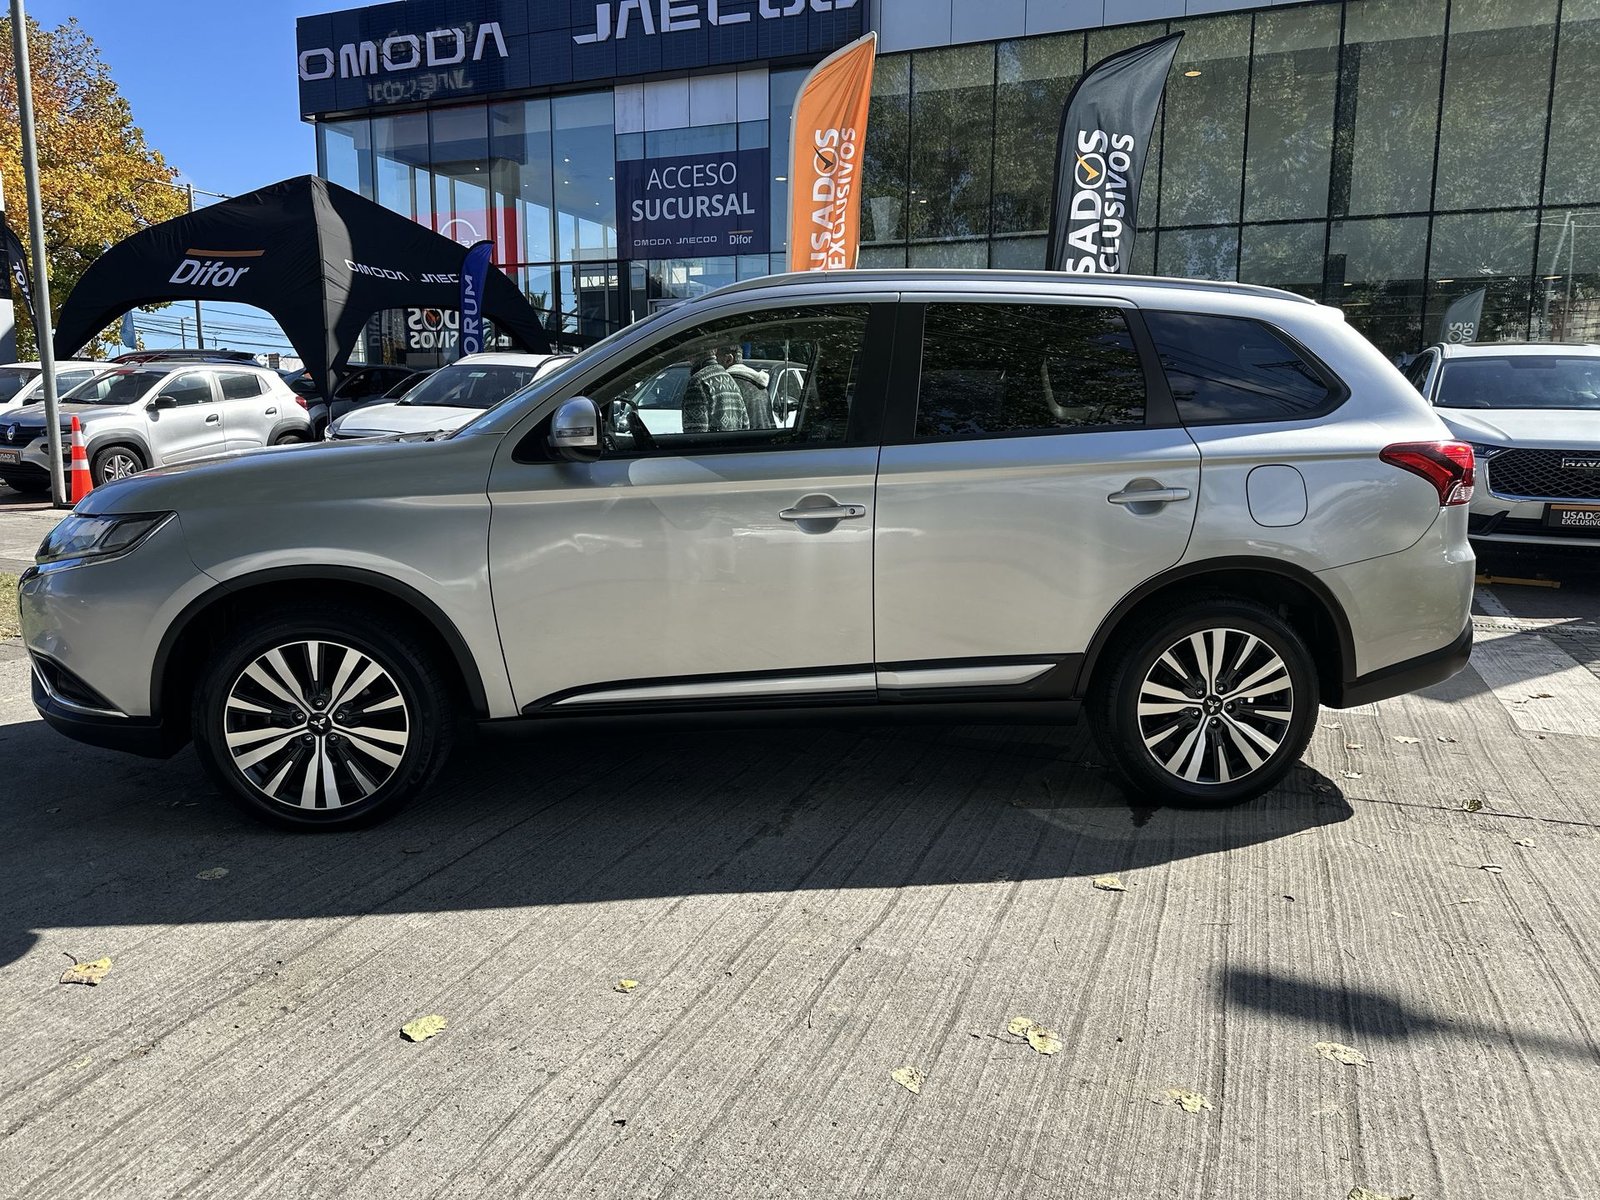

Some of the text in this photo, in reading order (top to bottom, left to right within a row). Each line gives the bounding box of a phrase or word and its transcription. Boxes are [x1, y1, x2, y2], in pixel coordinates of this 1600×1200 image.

[299, 22, 508, 81] OMODA
[646, 161, 737, 191] ACCESO
[631, 192, 755, 222] SUCURSAL
[810, 128, 839, 272] USADOS
[828, 127, 856, 269] EXCLUSIVOS
[633, 234, 753, 247] OMODA JAECOO Difor
[168, 259, 250, 287] Difor
[344, 258, 410, 282] OMODA
[464, 274, 479, 355] ORUM
